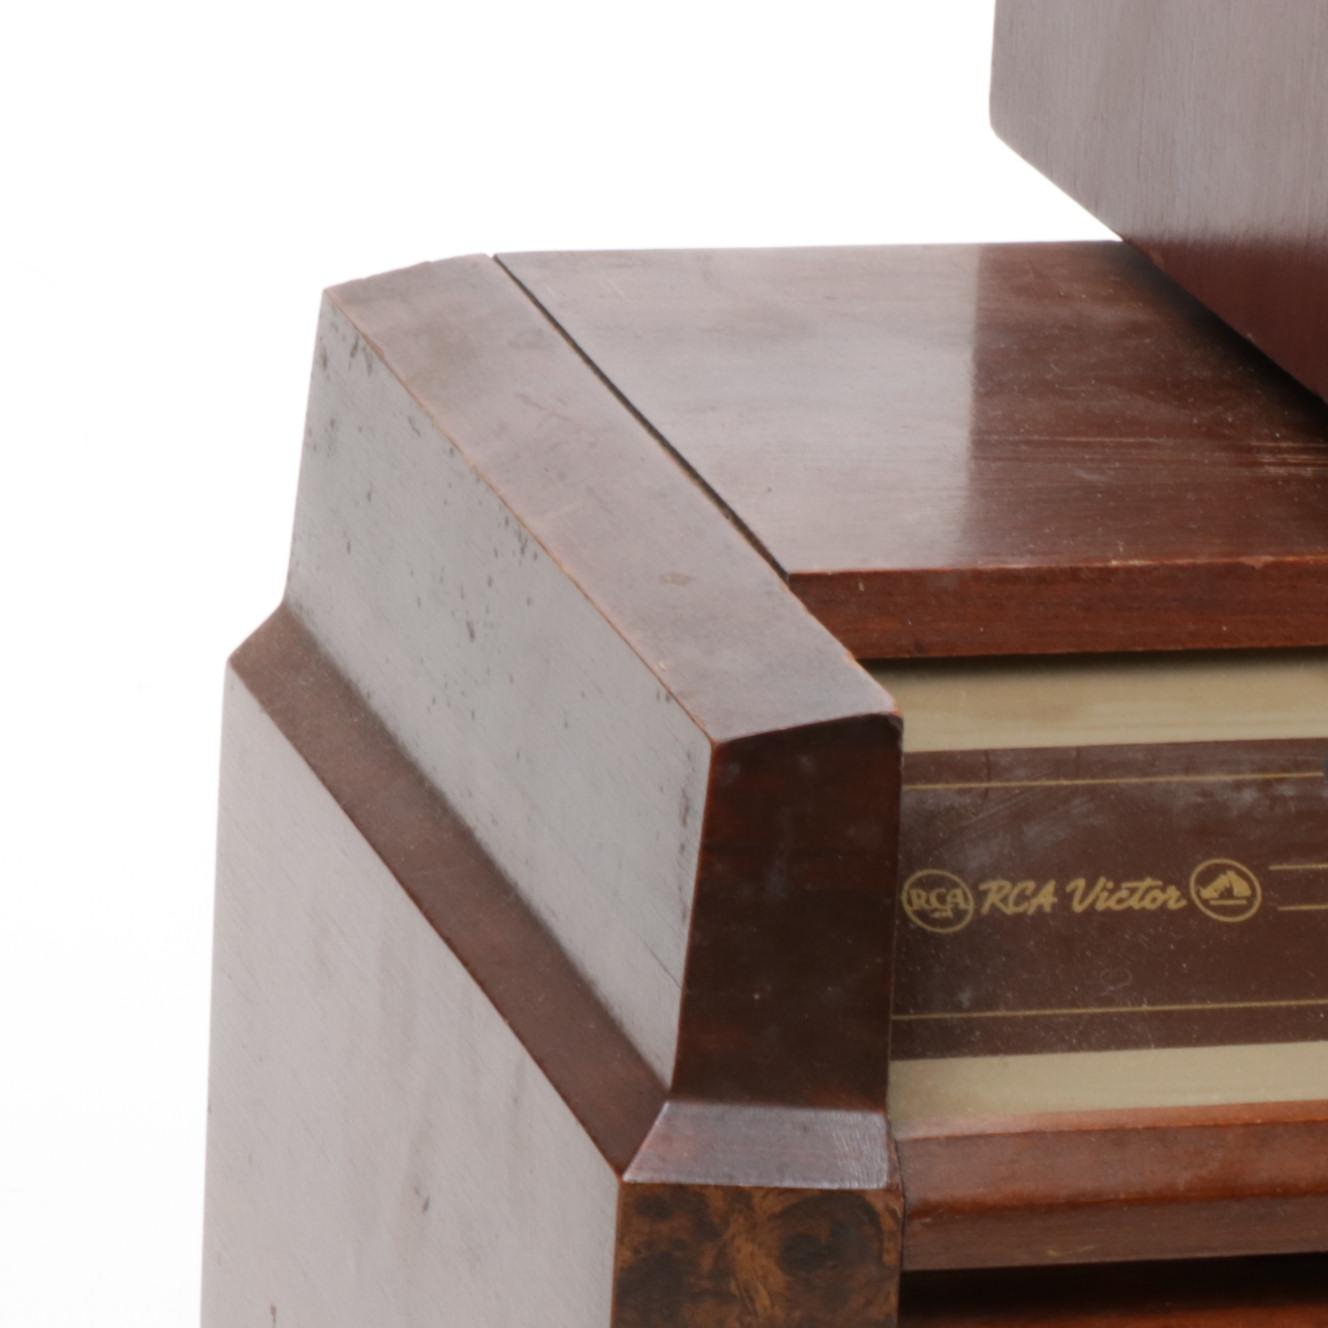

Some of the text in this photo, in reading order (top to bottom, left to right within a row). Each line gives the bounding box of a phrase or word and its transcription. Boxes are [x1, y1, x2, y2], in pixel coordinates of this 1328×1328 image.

[908, 886, 971, 914] RCA
[978, 876, 1188, 915] RCA Victor
